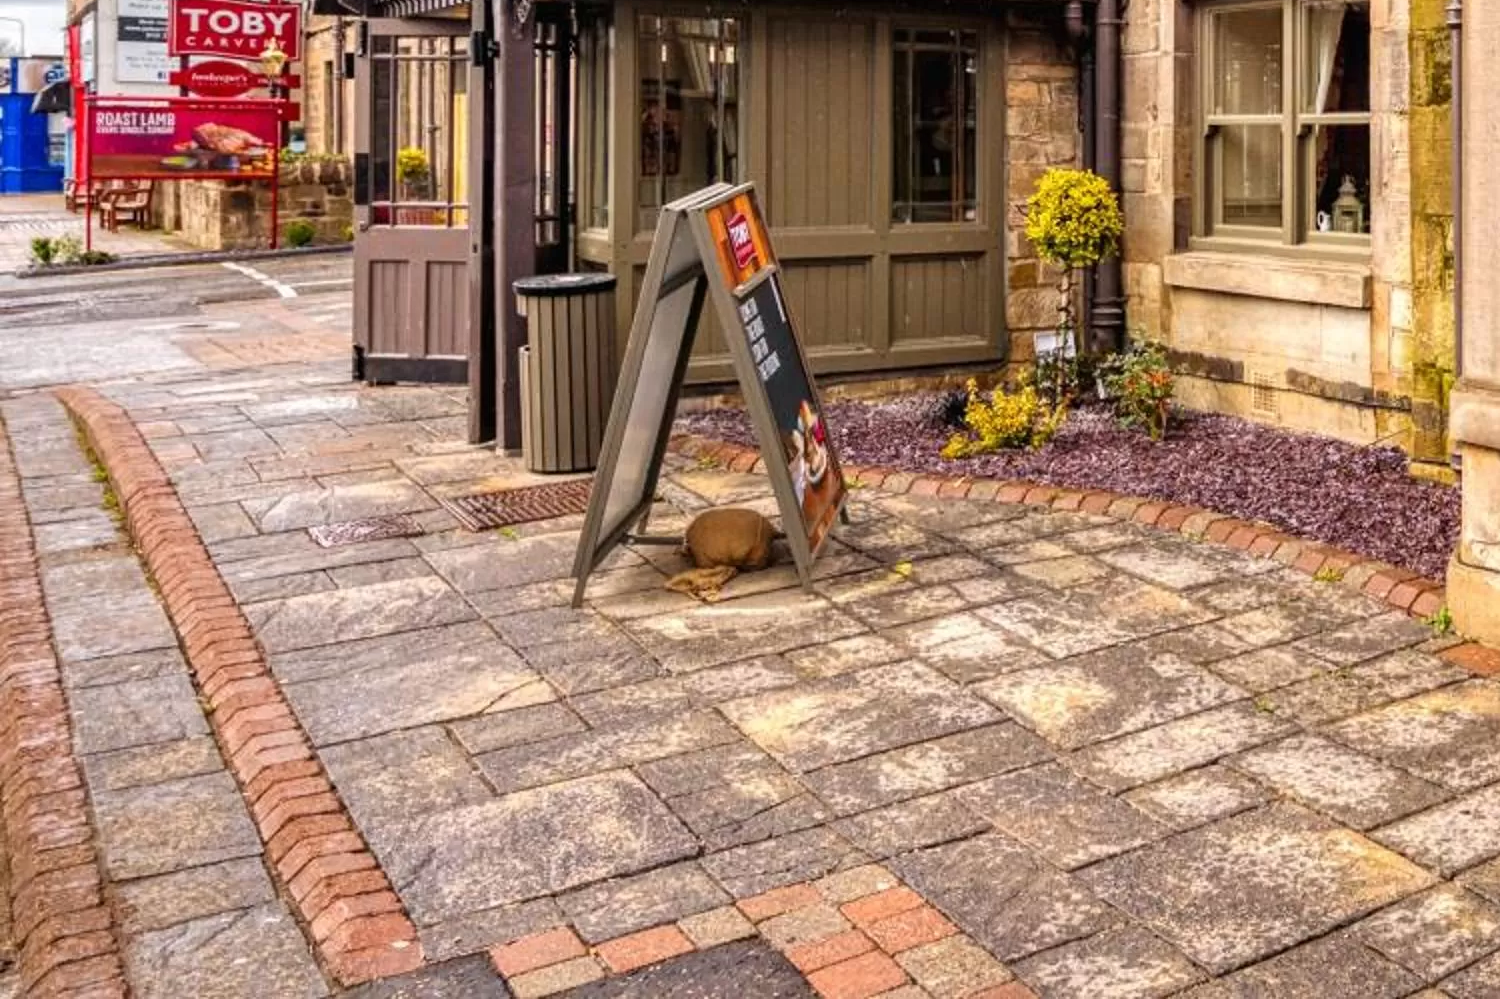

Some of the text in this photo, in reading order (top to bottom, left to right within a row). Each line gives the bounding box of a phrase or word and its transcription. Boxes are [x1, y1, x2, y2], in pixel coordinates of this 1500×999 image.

[181, 8, 291, 36] TOBY
[96, 112, 176, 126] ROAST LAMB
